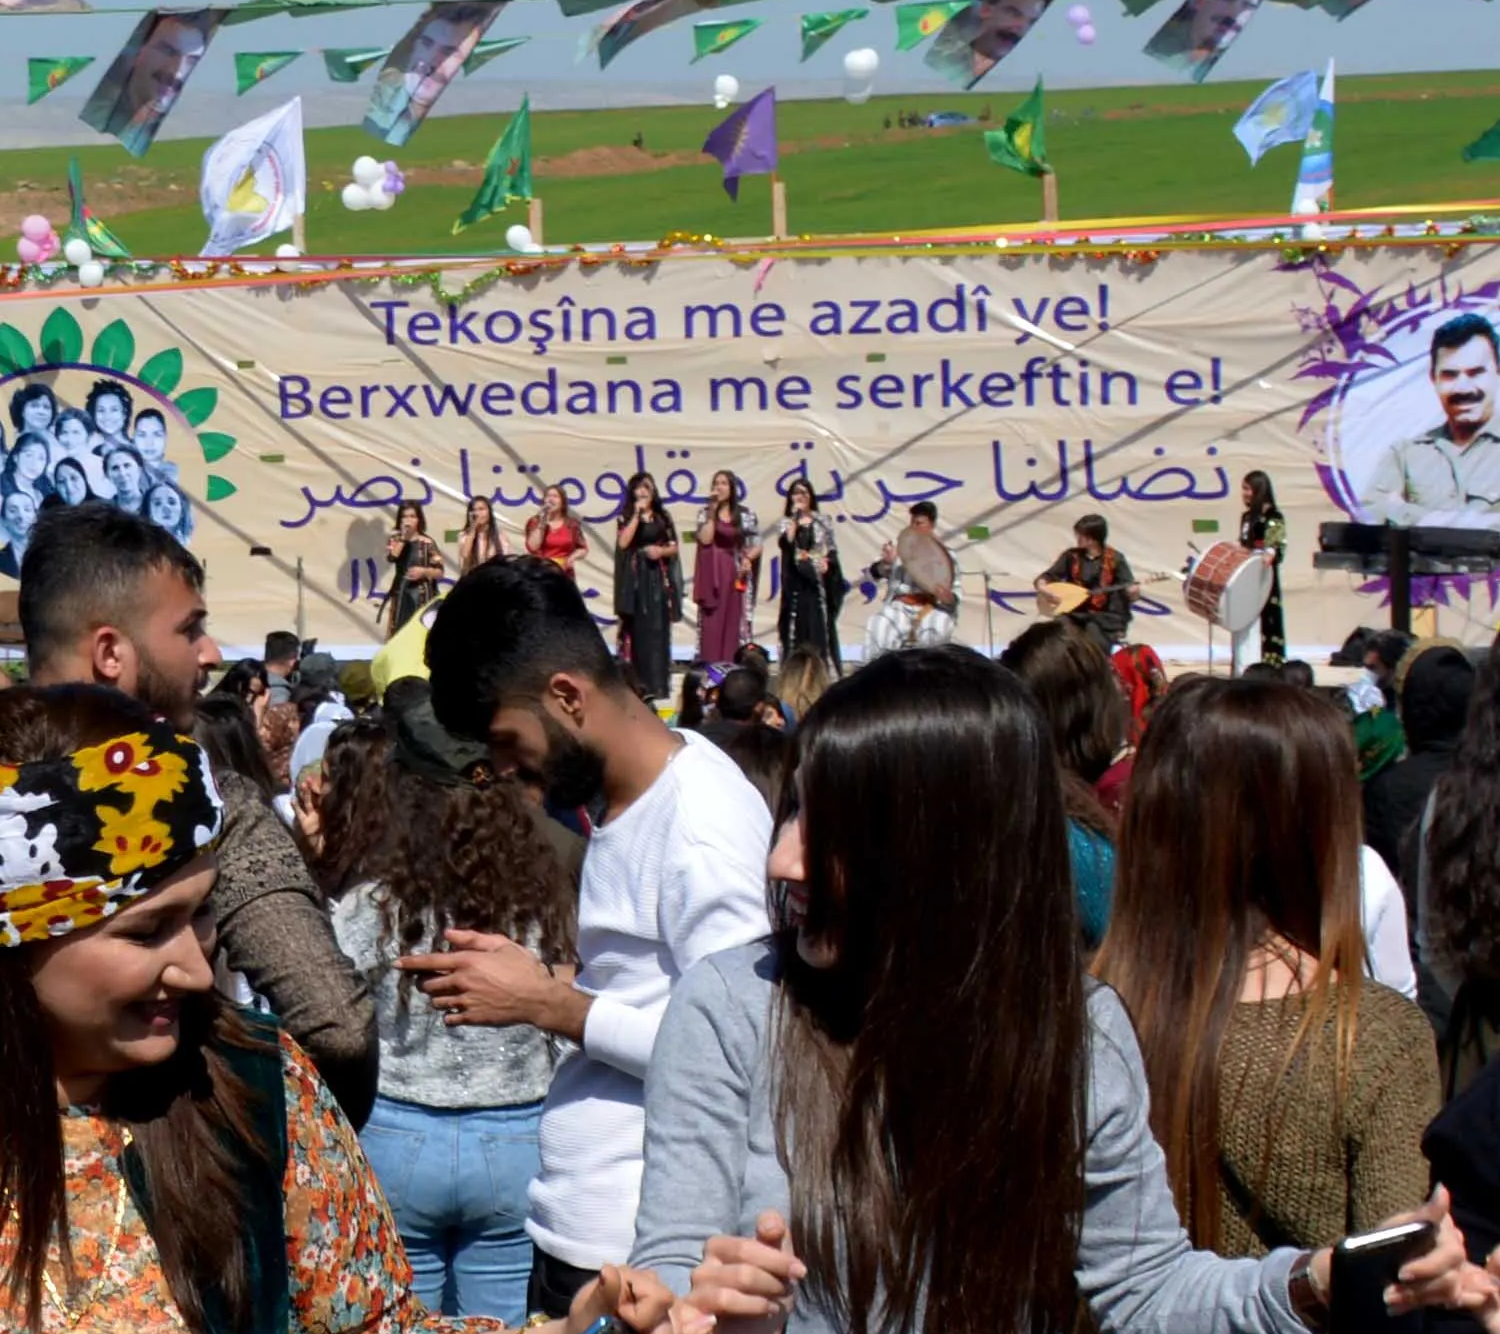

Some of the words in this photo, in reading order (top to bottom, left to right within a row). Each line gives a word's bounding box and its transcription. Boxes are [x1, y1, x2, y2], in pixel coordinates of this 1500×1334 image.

[370, 295, 656, 355] Tekoşîna
[684, 302, 786, 339] me
[809, 283, 990, 336] azadî
[1013, 283, 1110, 345] ye!
[278, 367, 682, 419] Berxwedana
[711, 375, 812, 411] me
[836, 356, 1137, 410] serkeftin
[1165, 357, 1222, 406] e!
[279, 457, 434, 529] نصر
[992, 439, 1230, 503] نضالنا
